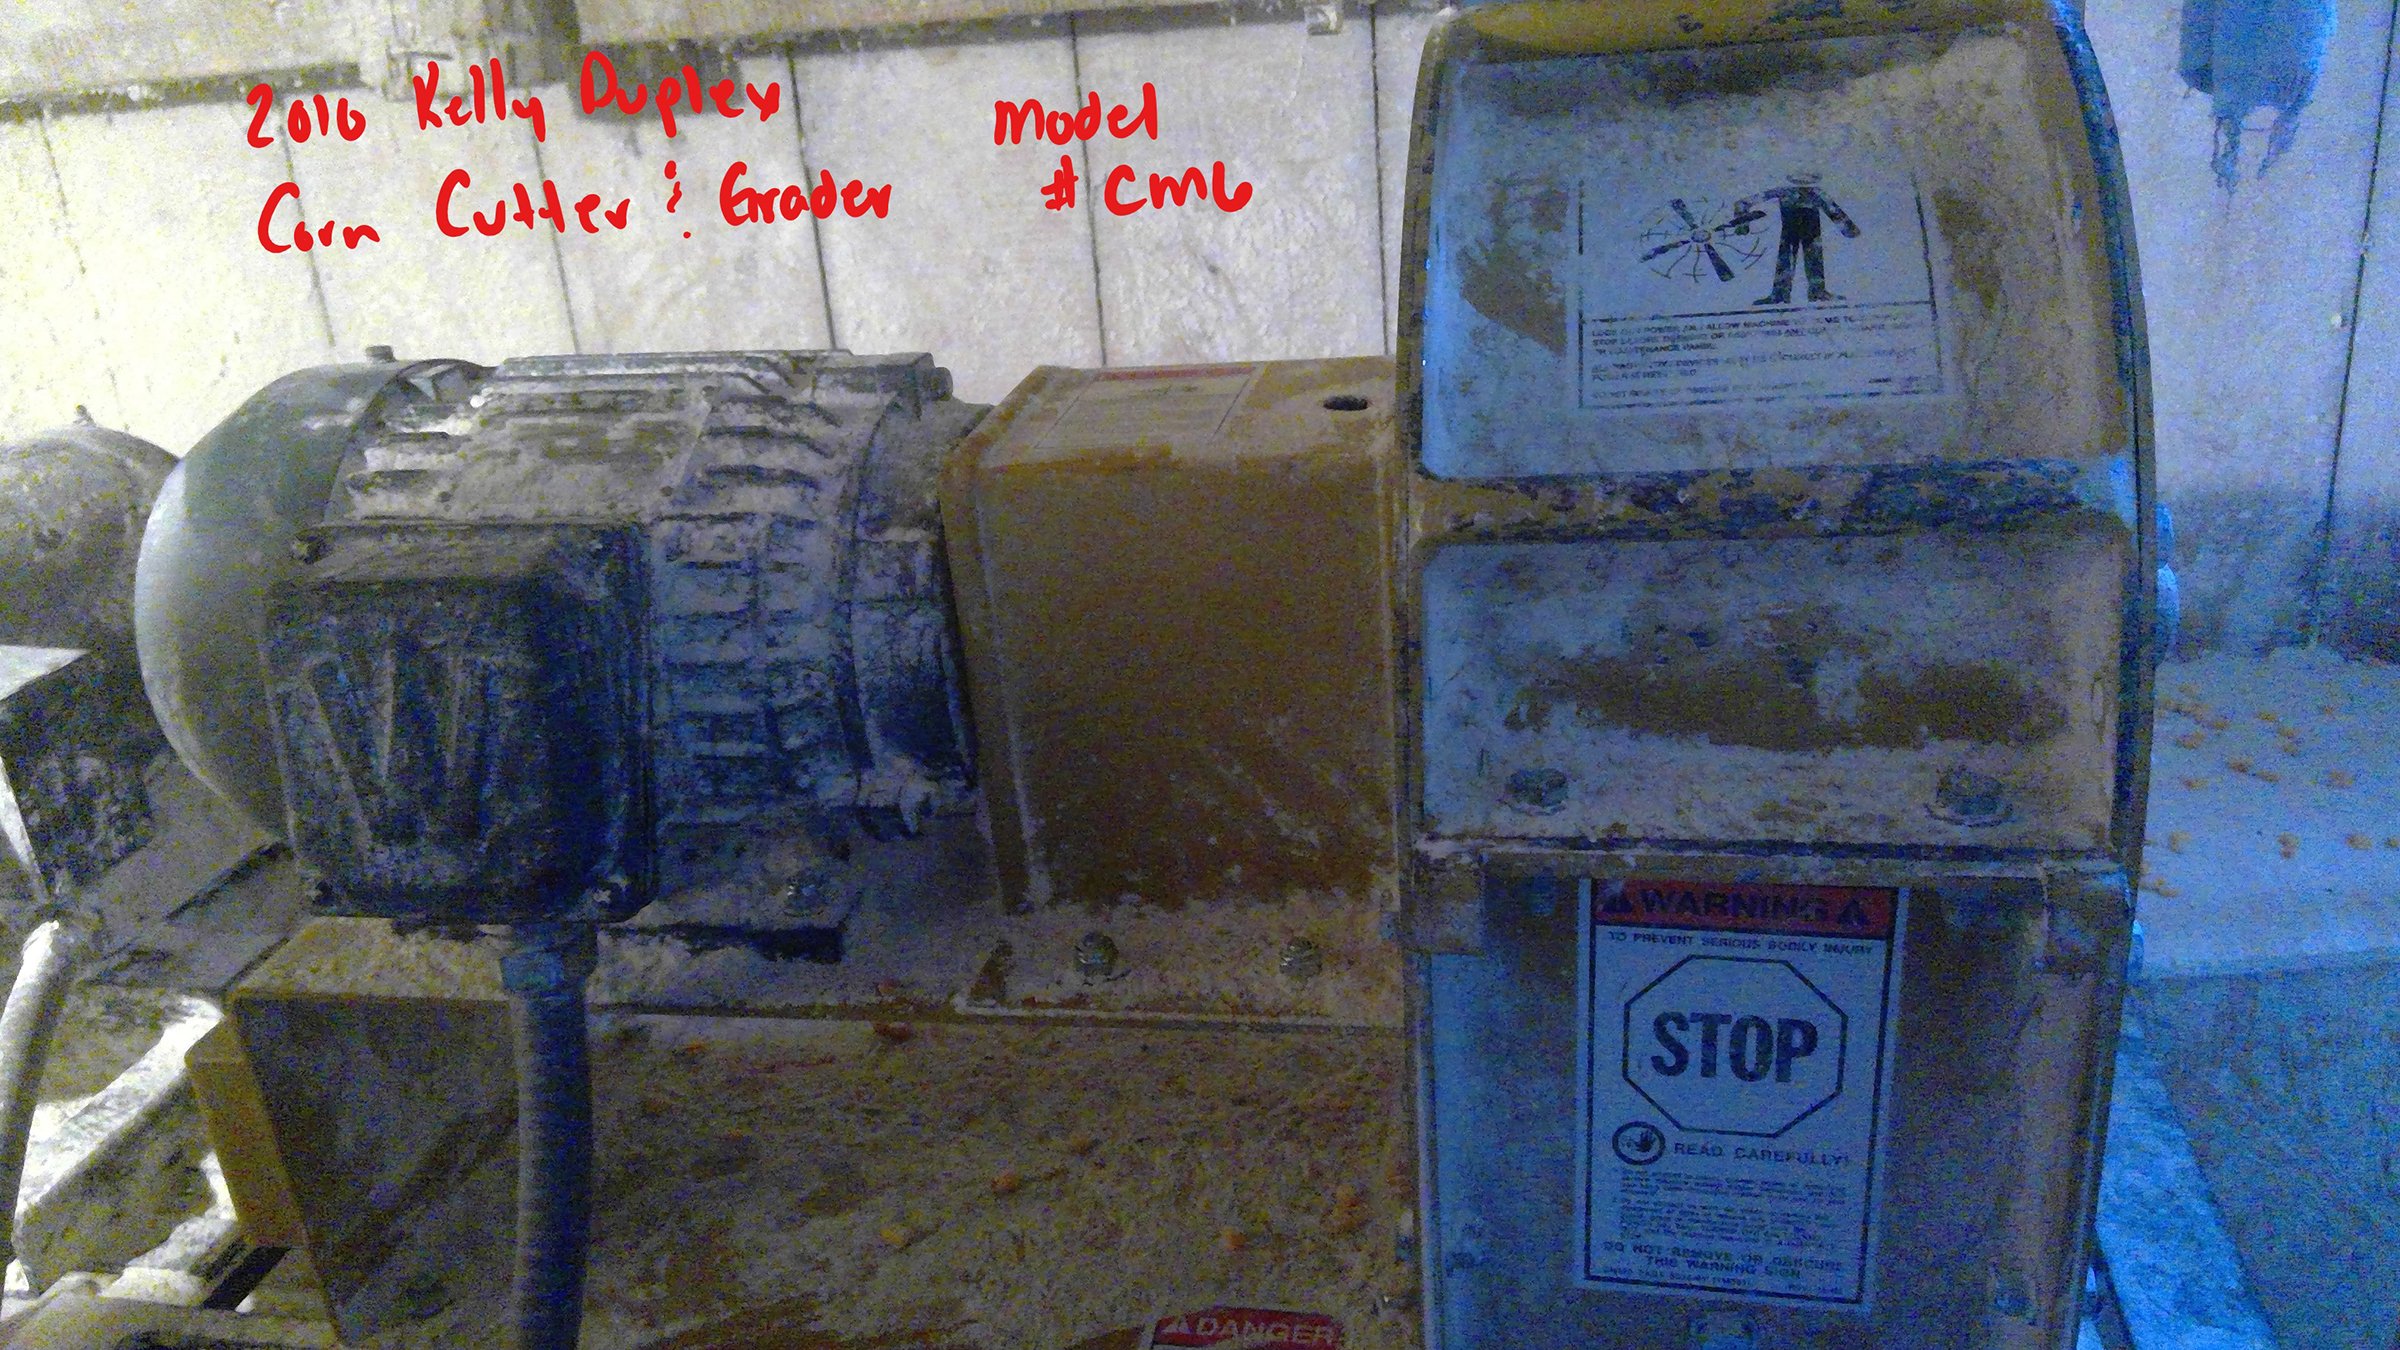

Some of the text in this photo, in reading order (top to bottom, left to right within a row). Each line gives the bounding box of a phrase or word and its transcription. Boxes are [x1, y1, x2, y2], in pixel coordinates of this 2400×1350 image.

[1640, 888, 1829, 922] WARNING
[1608, 930, 1873, 956] TO PREVENT SERIOUS BODILY INJURY
[1650, 1011, 1819, 1083] STOP
[1674, 1142, 1850, 1166] READ CAREFULLY!
[1603, 1240, 1625, 1252] DO
[1633, 1243, 1663, 1255] NOT
[1671, 1246, 1733, 1262] REMOVE
[1647, 1255, 1679, 1268] THIS
[1686, 1259, 1757, 1275] WARNING
[1764, 1265, 1802, 1280] SIGN
[1196, 1317, 1335, 1346] DANGER
